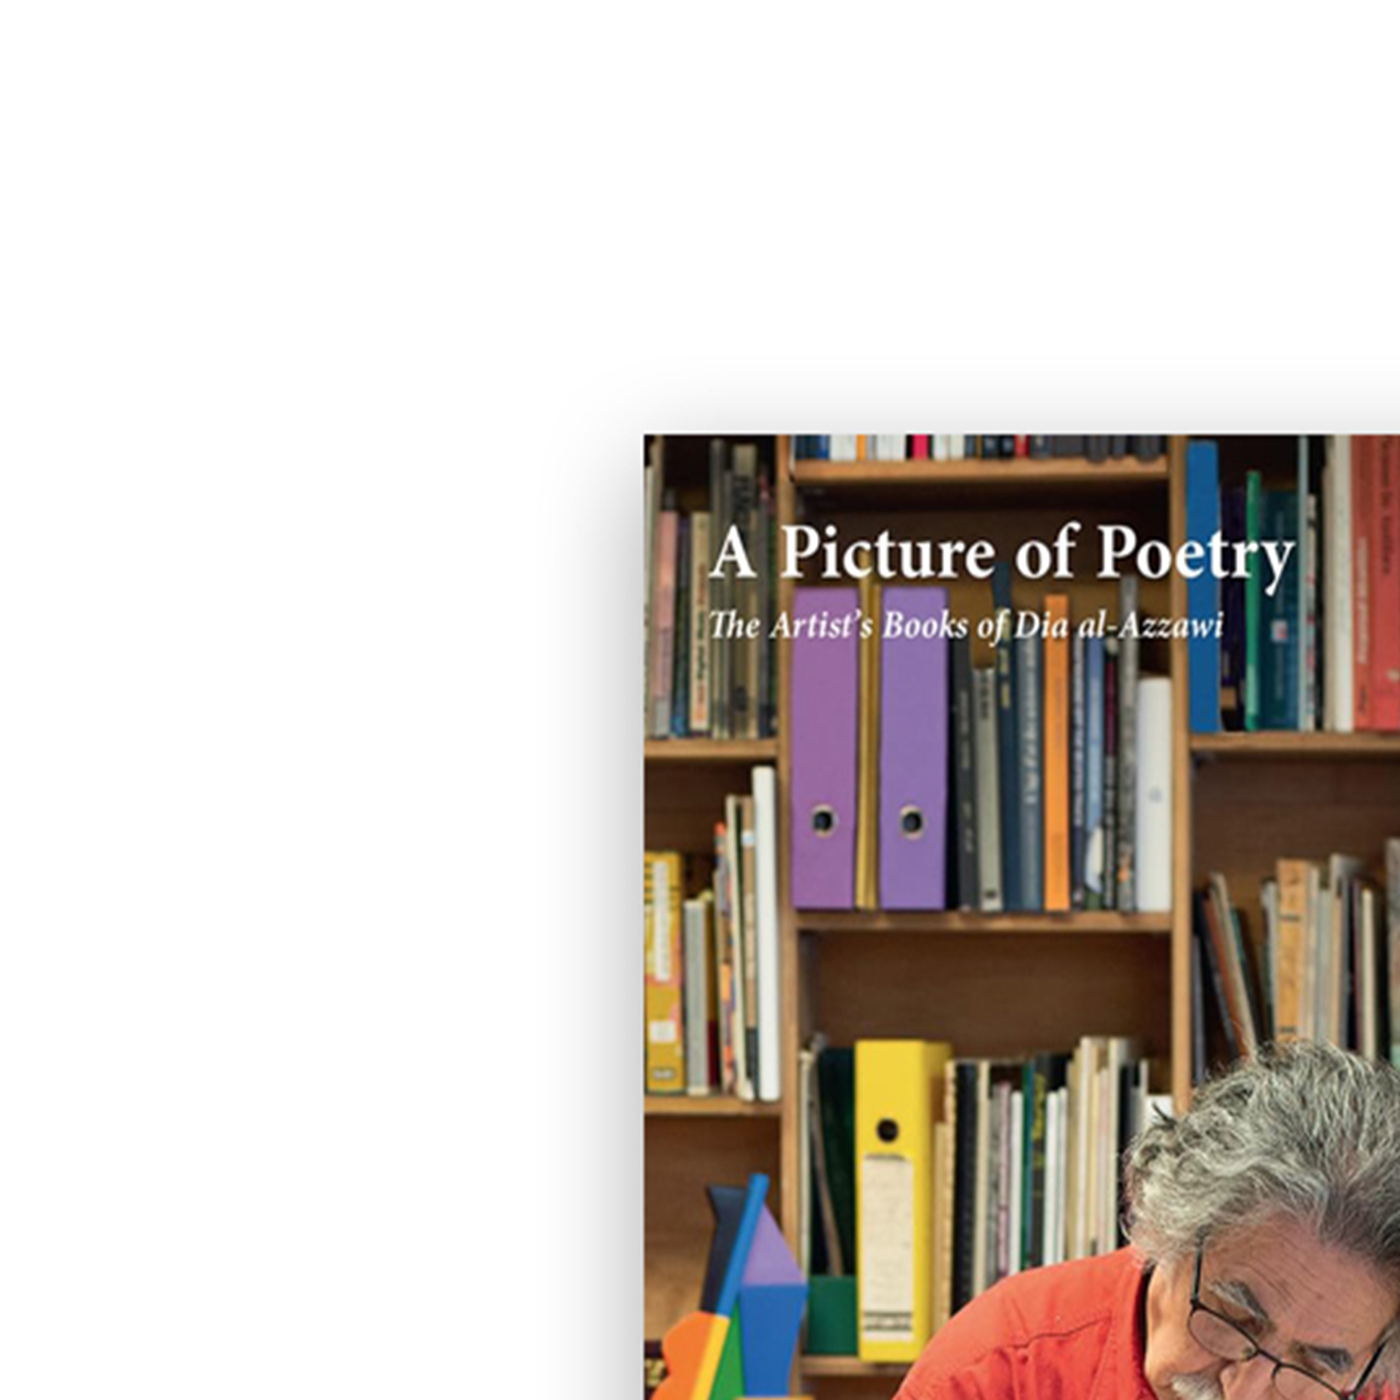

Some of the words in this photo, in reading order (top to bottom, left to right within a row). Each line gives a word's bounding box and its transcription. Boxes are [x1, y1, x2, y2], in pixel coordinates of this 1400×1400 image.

[709, 525, 756, 578] A
[782, 523, 996, 579] Picture
[1016, 522, 1081, 579] of
[1098, 525, 1295, 596] Poetry
[709, 610, 760, 639] The
[769, 609, 873, 640] Artist’s
[882, 609, 968, 640] Books
[977, 609, 1012, 647] of
[1014, 611, 1069, 639] Dia
[1078, 609, 1225, 640] al-Azzawi
